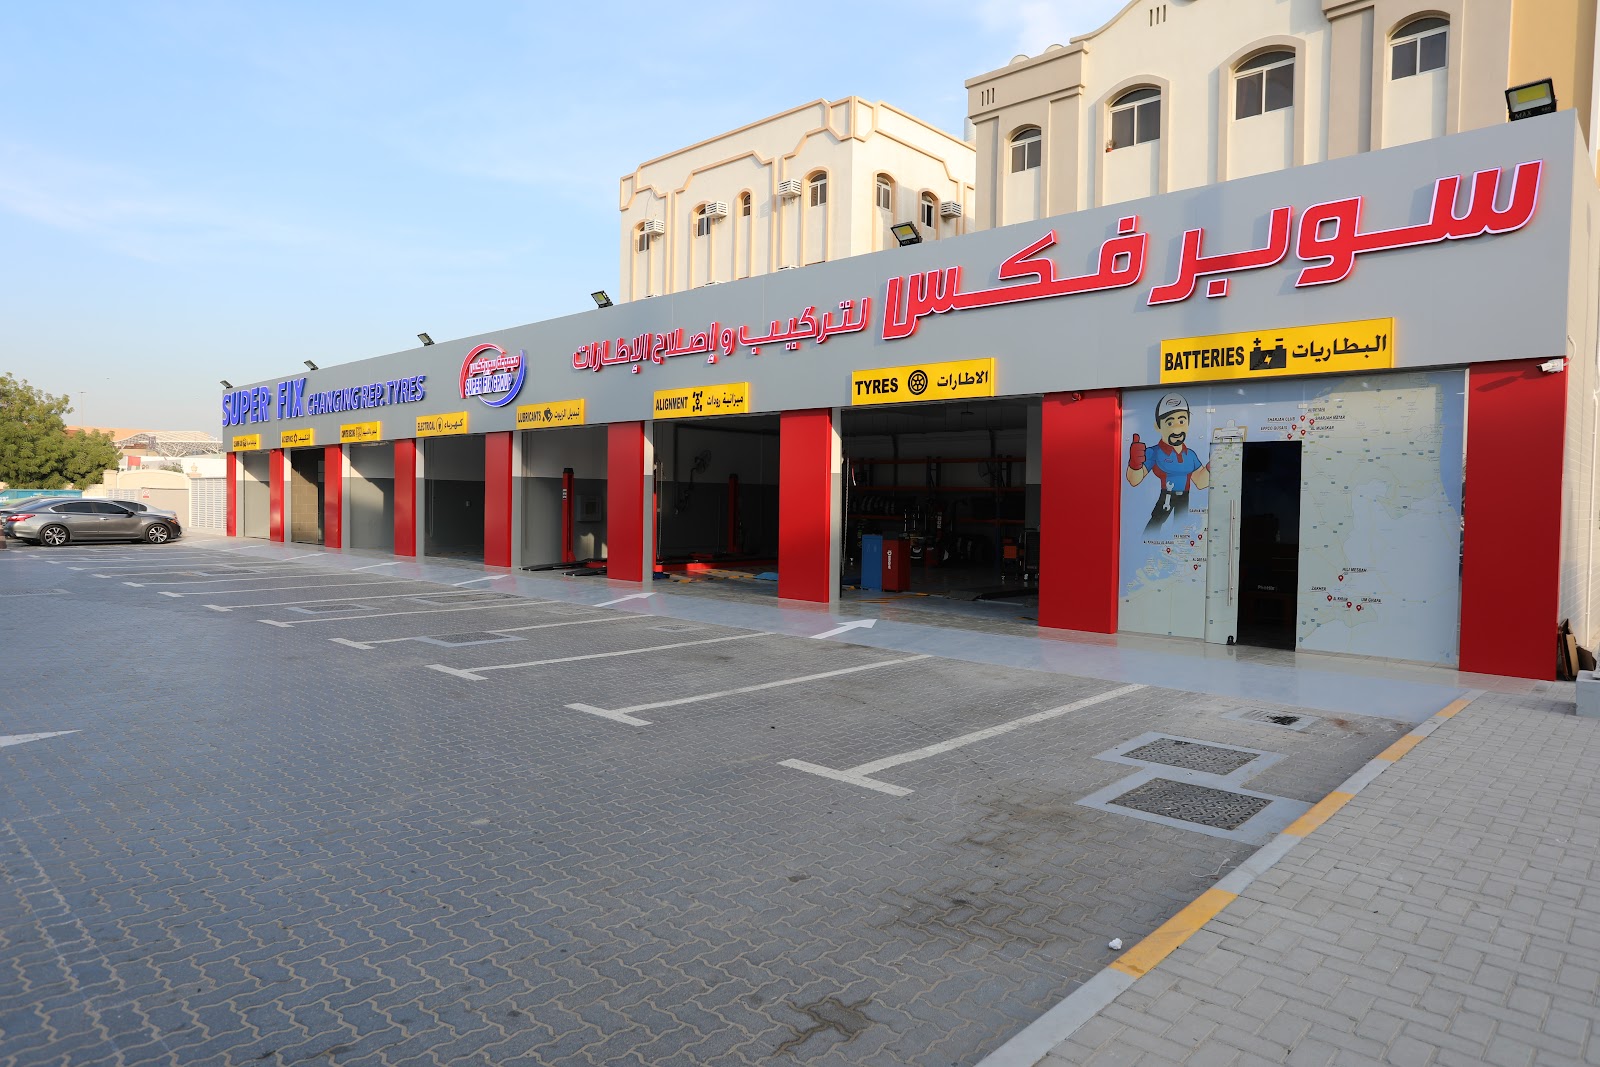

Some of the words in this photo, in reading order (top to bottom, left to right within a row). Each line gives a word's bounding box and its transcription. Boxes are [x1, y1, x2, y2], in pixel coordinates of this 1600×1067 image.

[1147, 160, 1544, 306] سوبر
[882, 215, 1148, 340] فكس
[738, 297, 873, 355] لتركيب
[572, 332, 653, 374] الإطارات
[1164, 345, 1246, 371] BATTERIES
[1291, 334, 1387, 363] البطاريات
[465, 377, 483, 396] SUPER
[482, 375, 493, 393] FIX
[492, 373, 513, 393] GROUP
[854, 377, 899, 396] TYRES
[937, 369, 989, 391] الاطارات
[222, 385, 271, 427] SUPER
[277, 377, 306, 420] FIX
[307, 388, 360, 416] CHANGING
[361, 382, 386, 408] REP.
[386, 374, 427, 405] TYRES
[655, 396, 689, 411] ALIGNMENT
[722, 392, 743, 408] ميزانية
[417, 421, 436, 432] ELECTRICAL
[444, 418, 464, 430] كهرباء
[517, 410, 542, 423] LUBRICANTS
